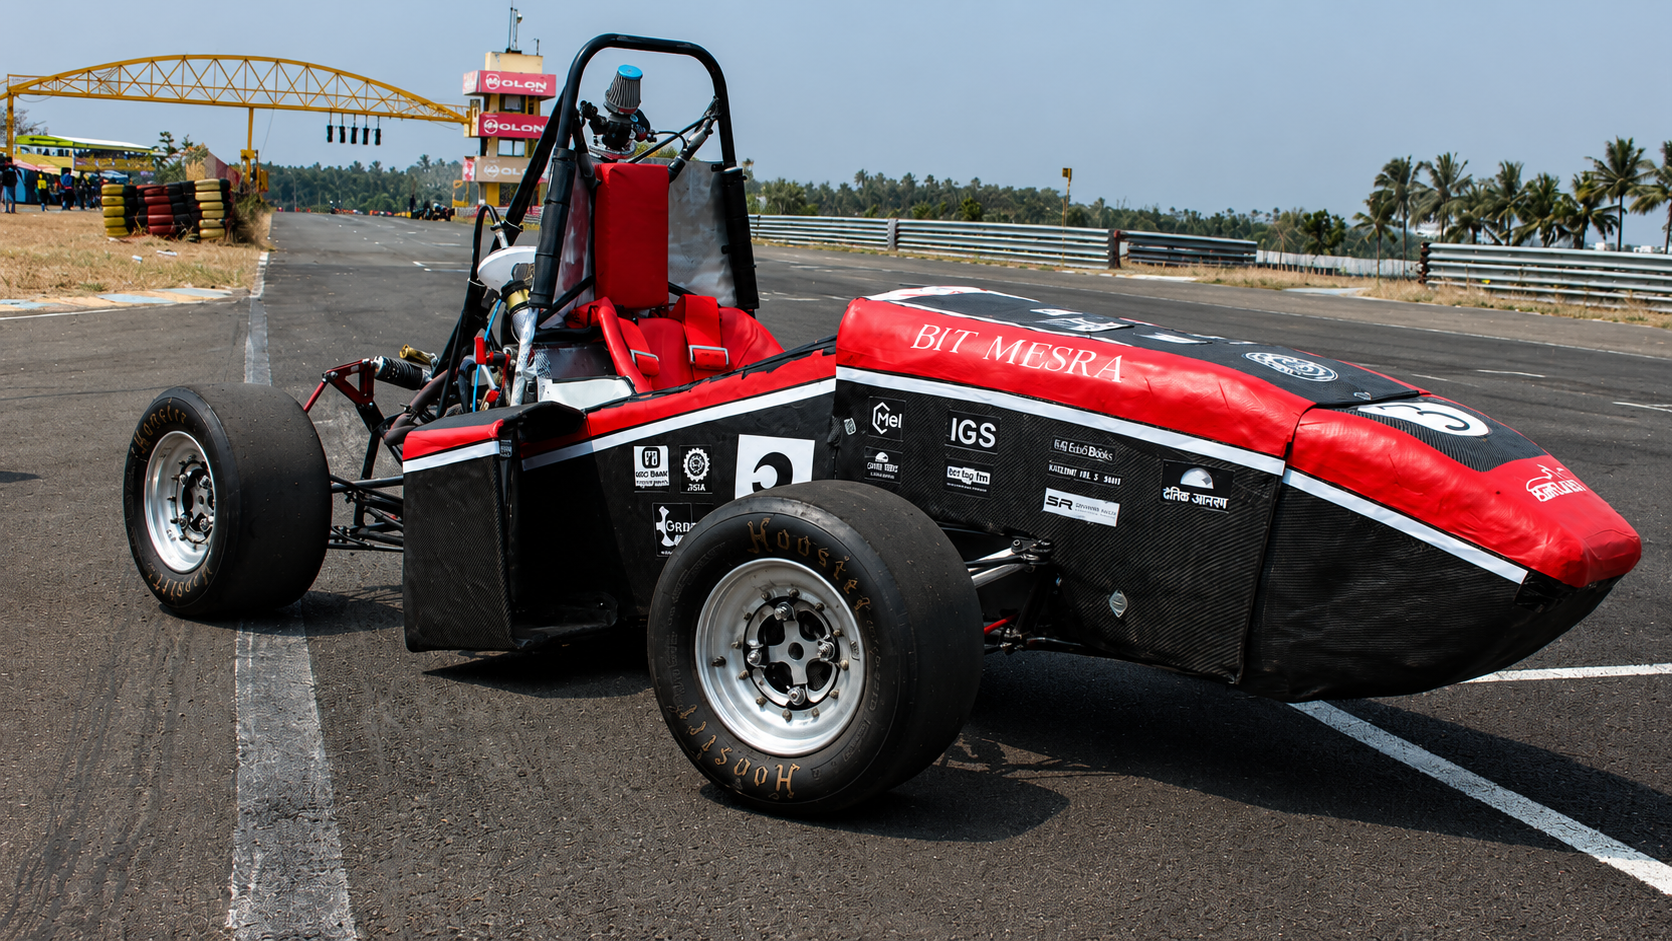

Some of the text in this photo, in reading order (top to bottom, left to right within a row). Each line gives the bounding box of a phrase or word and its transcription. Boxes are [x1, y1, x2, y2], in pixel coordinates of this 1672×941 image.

[911, 324, 1124, 383] BIT MESRA
[950, 417, 997, 448] IGS
[1046, 495, 1073, 511] SR
